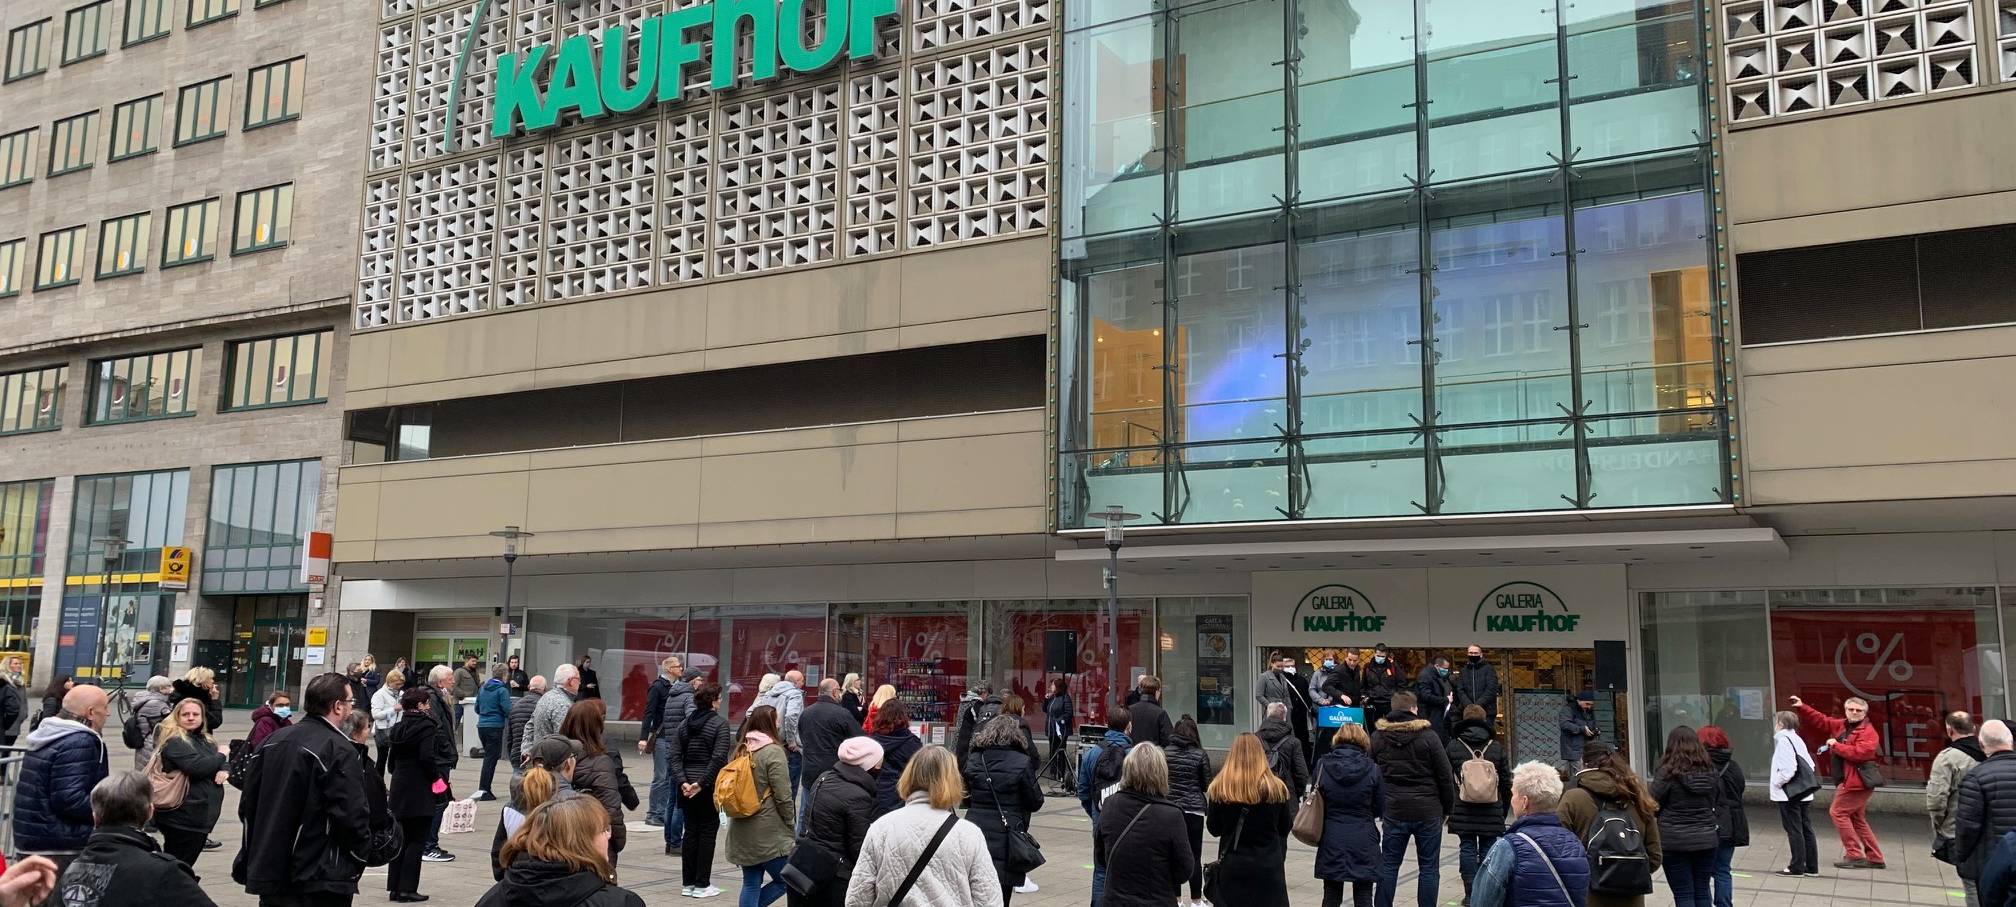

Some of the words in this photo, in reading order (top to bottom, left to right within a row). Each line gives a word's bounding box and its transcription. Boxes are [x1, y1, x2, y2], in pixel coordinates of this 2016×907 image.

[1312, 596, 1354, 610] GALERIA
[1496, 593, 1543, 609] GALERIA
[1877, 722, 1930, 758] LE
